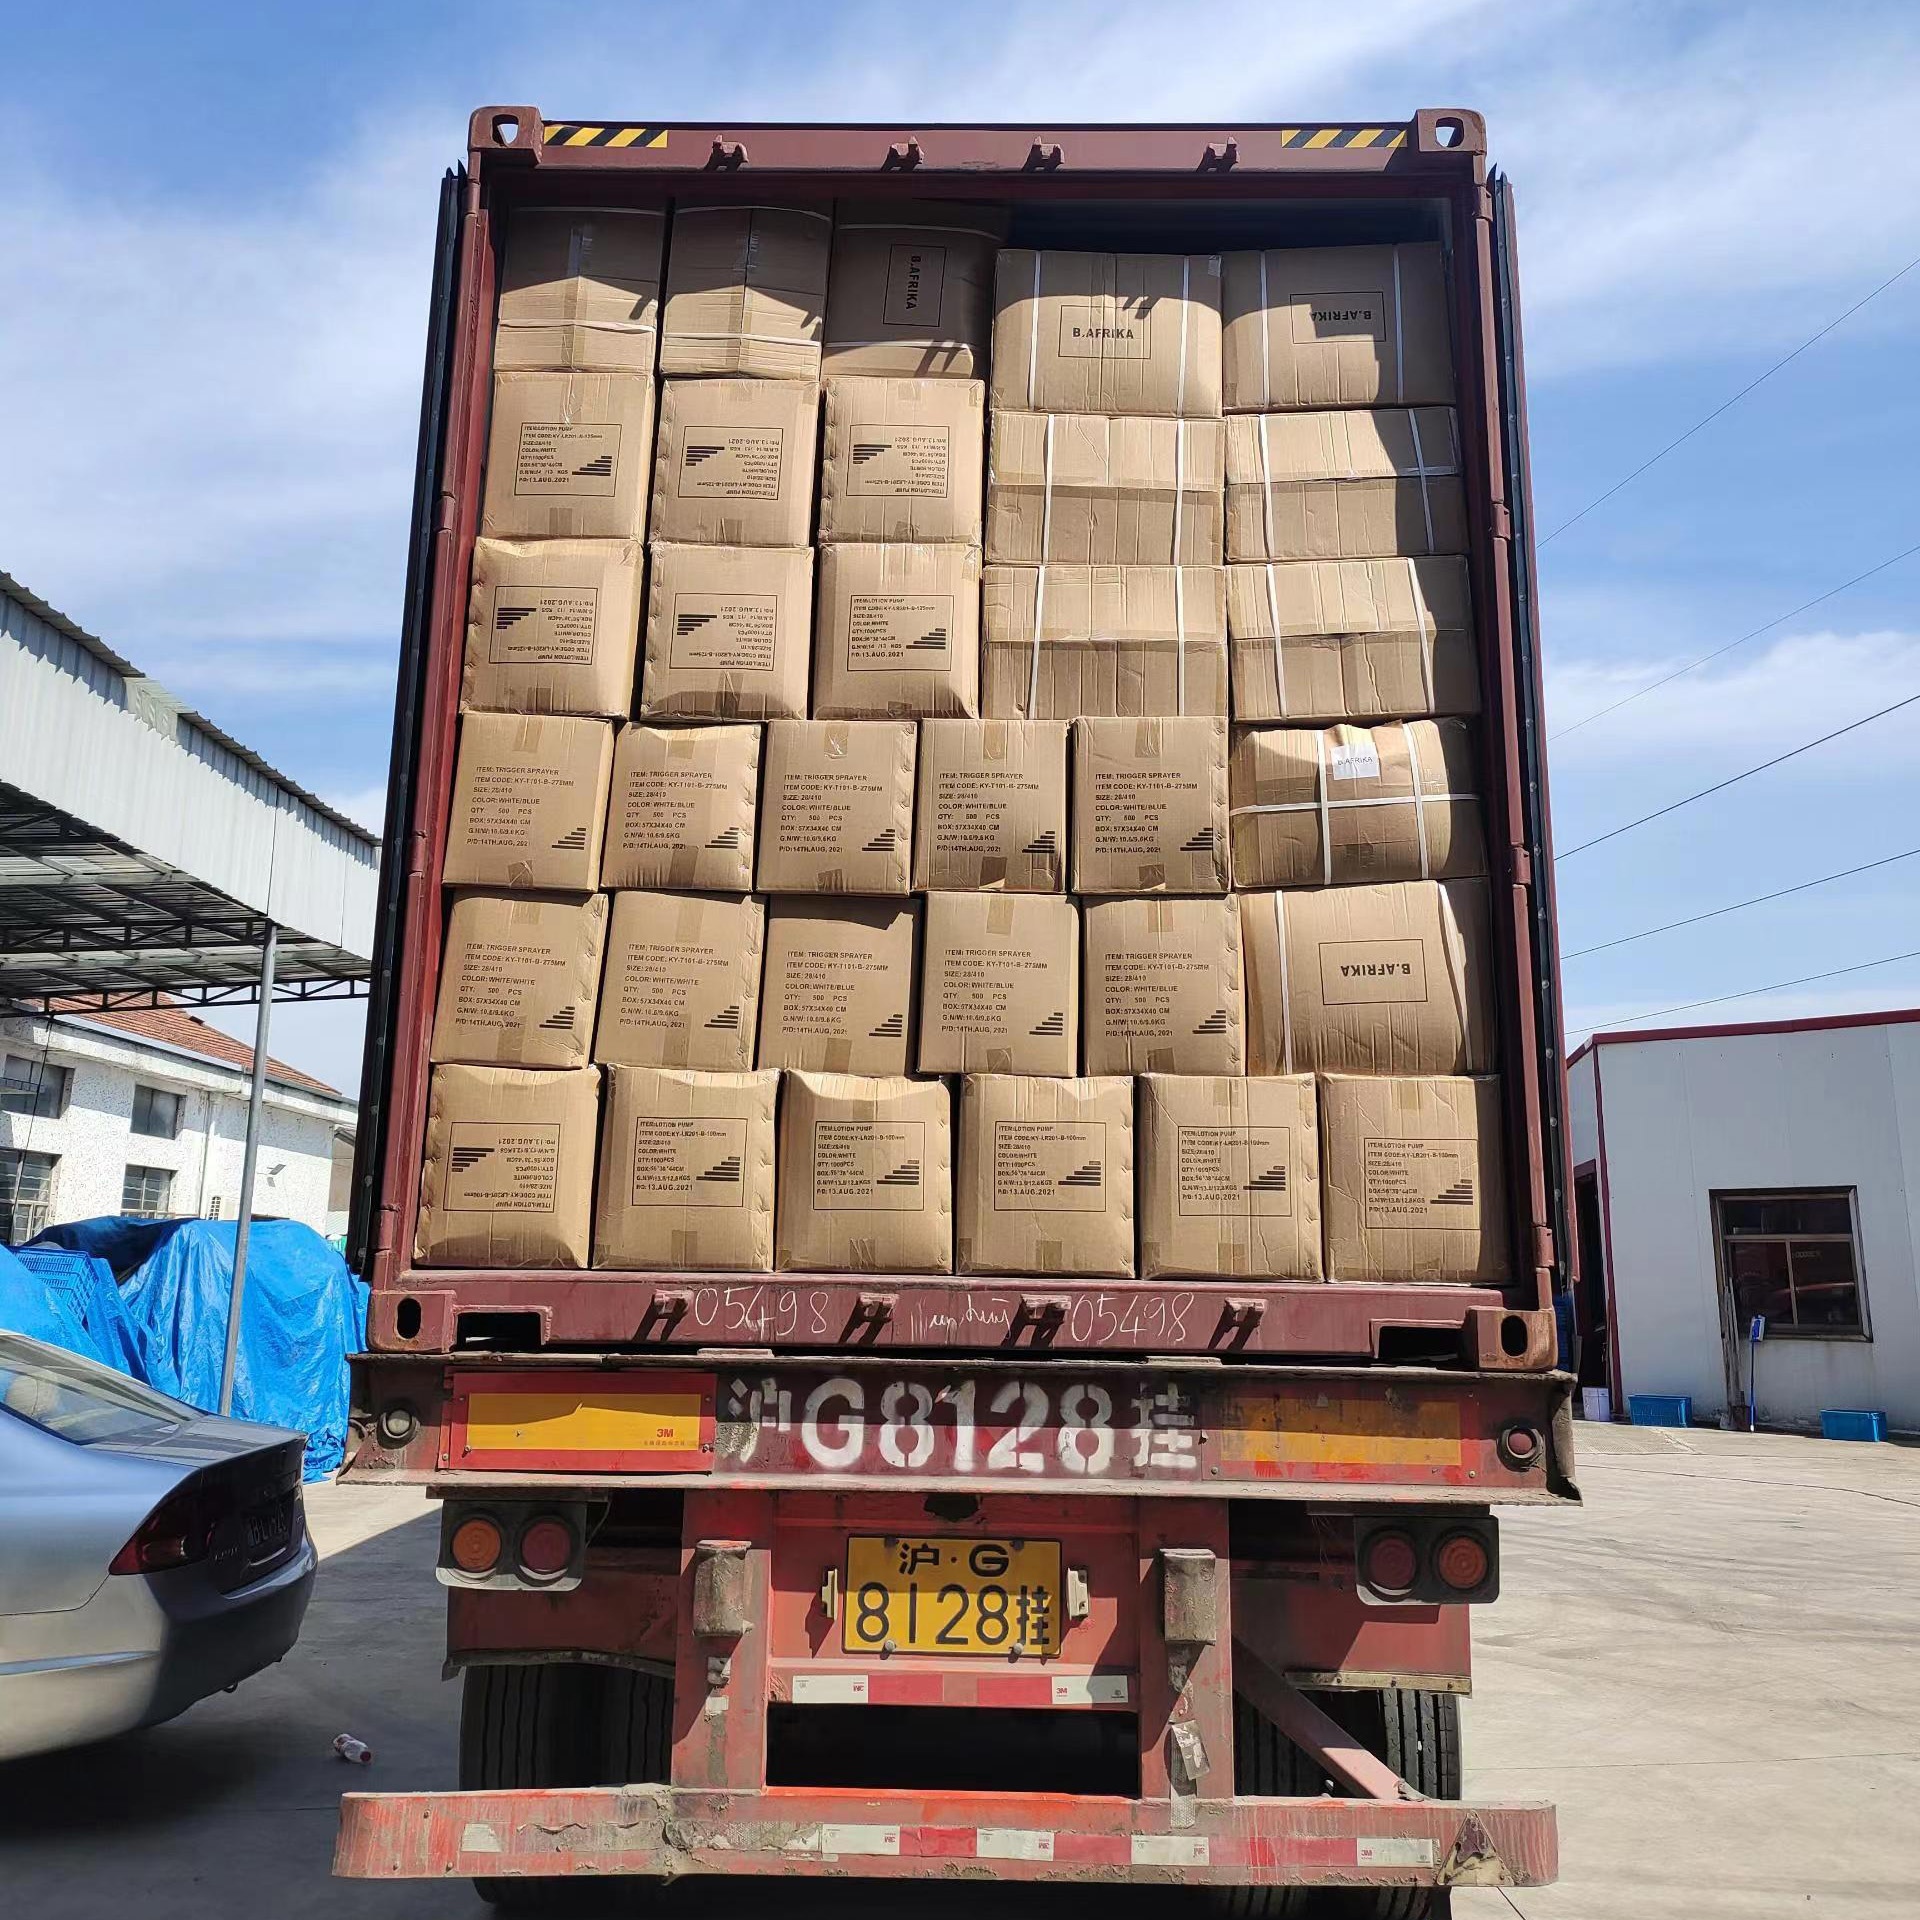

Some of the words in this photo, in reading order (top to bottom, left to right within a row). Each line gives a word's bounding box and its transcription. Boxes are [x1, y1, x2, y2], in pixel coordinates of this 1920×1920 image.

[905, 255, 921, 310] B.AFRIKA
[1310, 310, 1372, 322] B.AFRIKA
[1072, 327, 1134, 339] B.AFRIKA
[518, 946, 550, 954] SPRAYER
[649, 944, 679, 952] TRIGGER
[681, 946, 713, 954] SPRAYER
[1340, 963, 1411, 977] B.AFRIKA
[695, 1285, 828, 1339] 05498
[1071, 1292, 1194, 1343] 05498
[656, 1428, 674, 1438] 3M
[856, 1581, 1050, 1646] 8128挂
